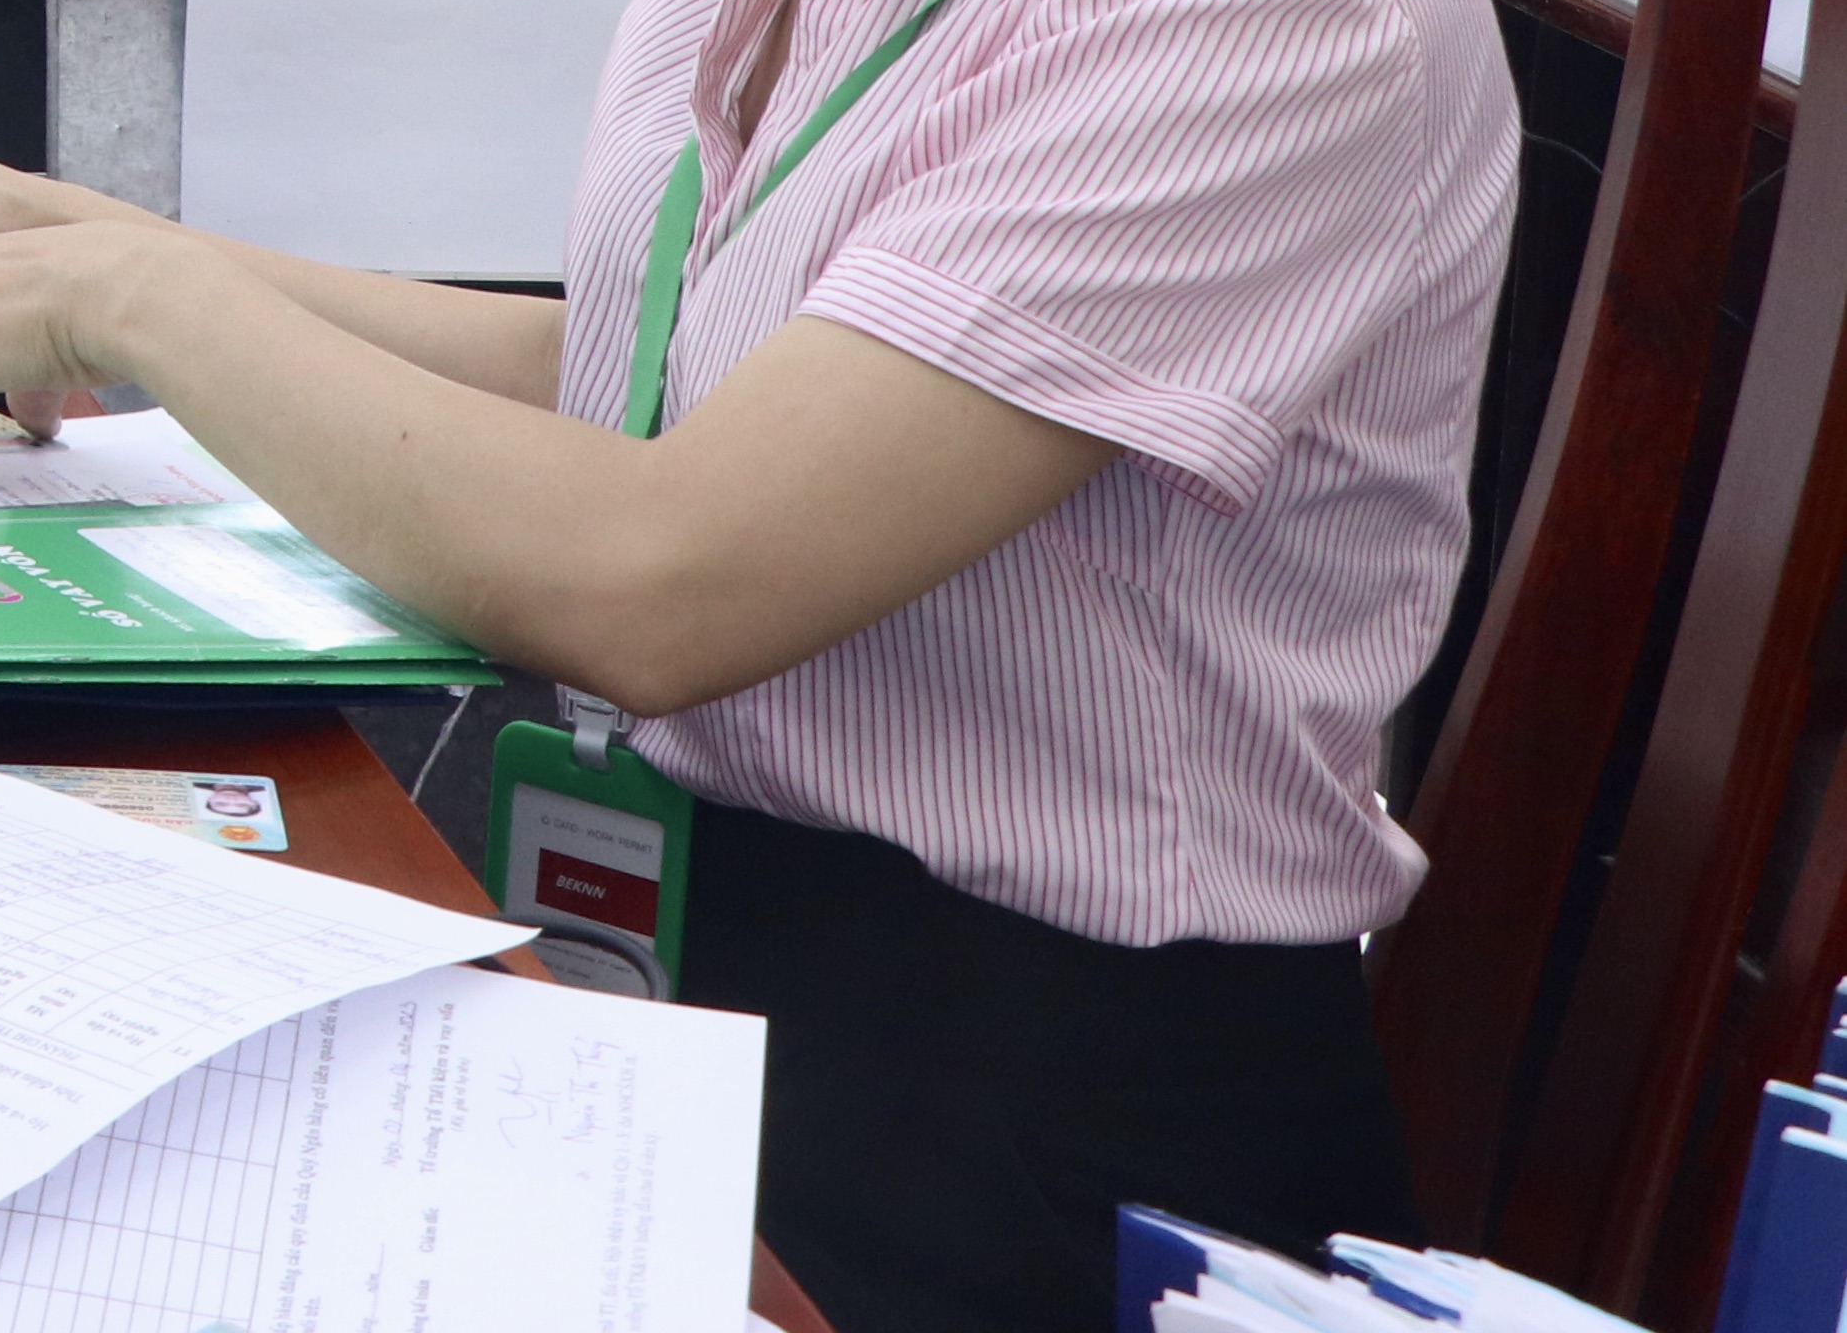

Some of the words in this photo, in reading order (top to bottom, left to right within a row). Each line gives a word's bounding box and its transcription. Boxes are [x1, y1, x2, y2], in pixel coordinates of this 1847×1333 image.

[39, 578, 103, 607] VAY
[79, 610, 143, 627] SỔ
[556, 874, 608, 900] BEKNN
